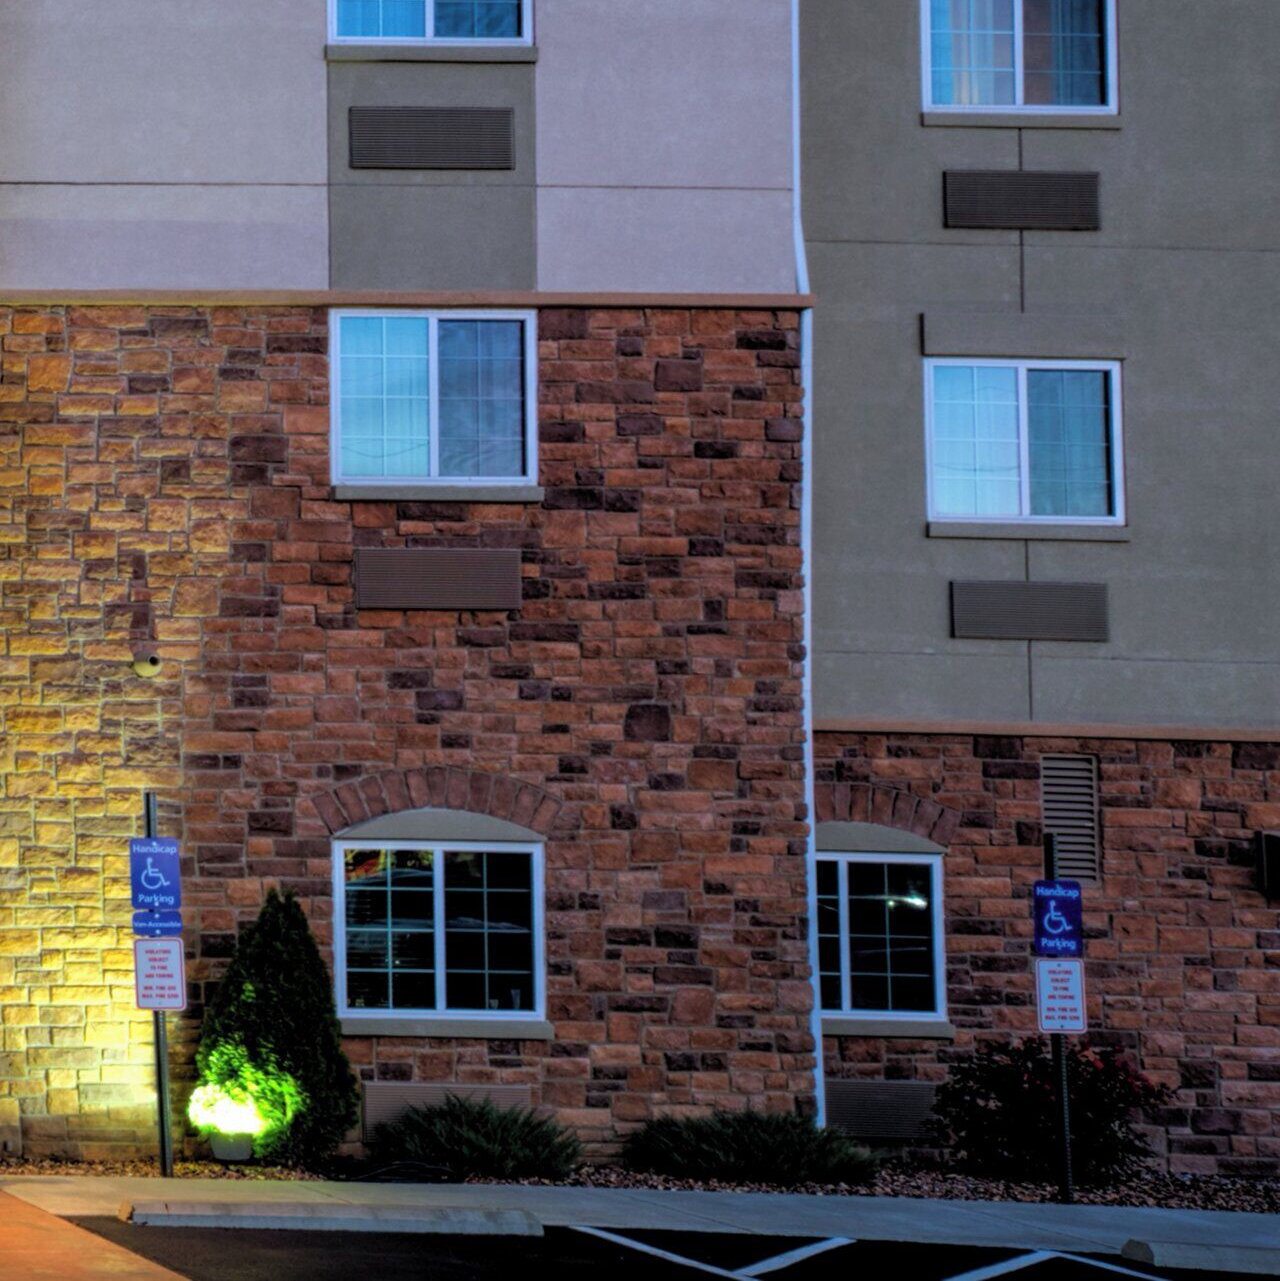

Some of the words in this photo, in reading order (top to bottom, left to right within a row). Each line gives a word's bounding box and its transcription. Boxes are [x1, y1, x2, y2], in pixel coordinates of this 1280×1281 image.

[132, 844, 177, 855] Handicap
[1036, 887, 1080, 898] Handicap
[138, 893, 175, 905] Parking
[133, 920, 182, 928] Van-Accessible
[1041, 938, 1076, 950] Parking
